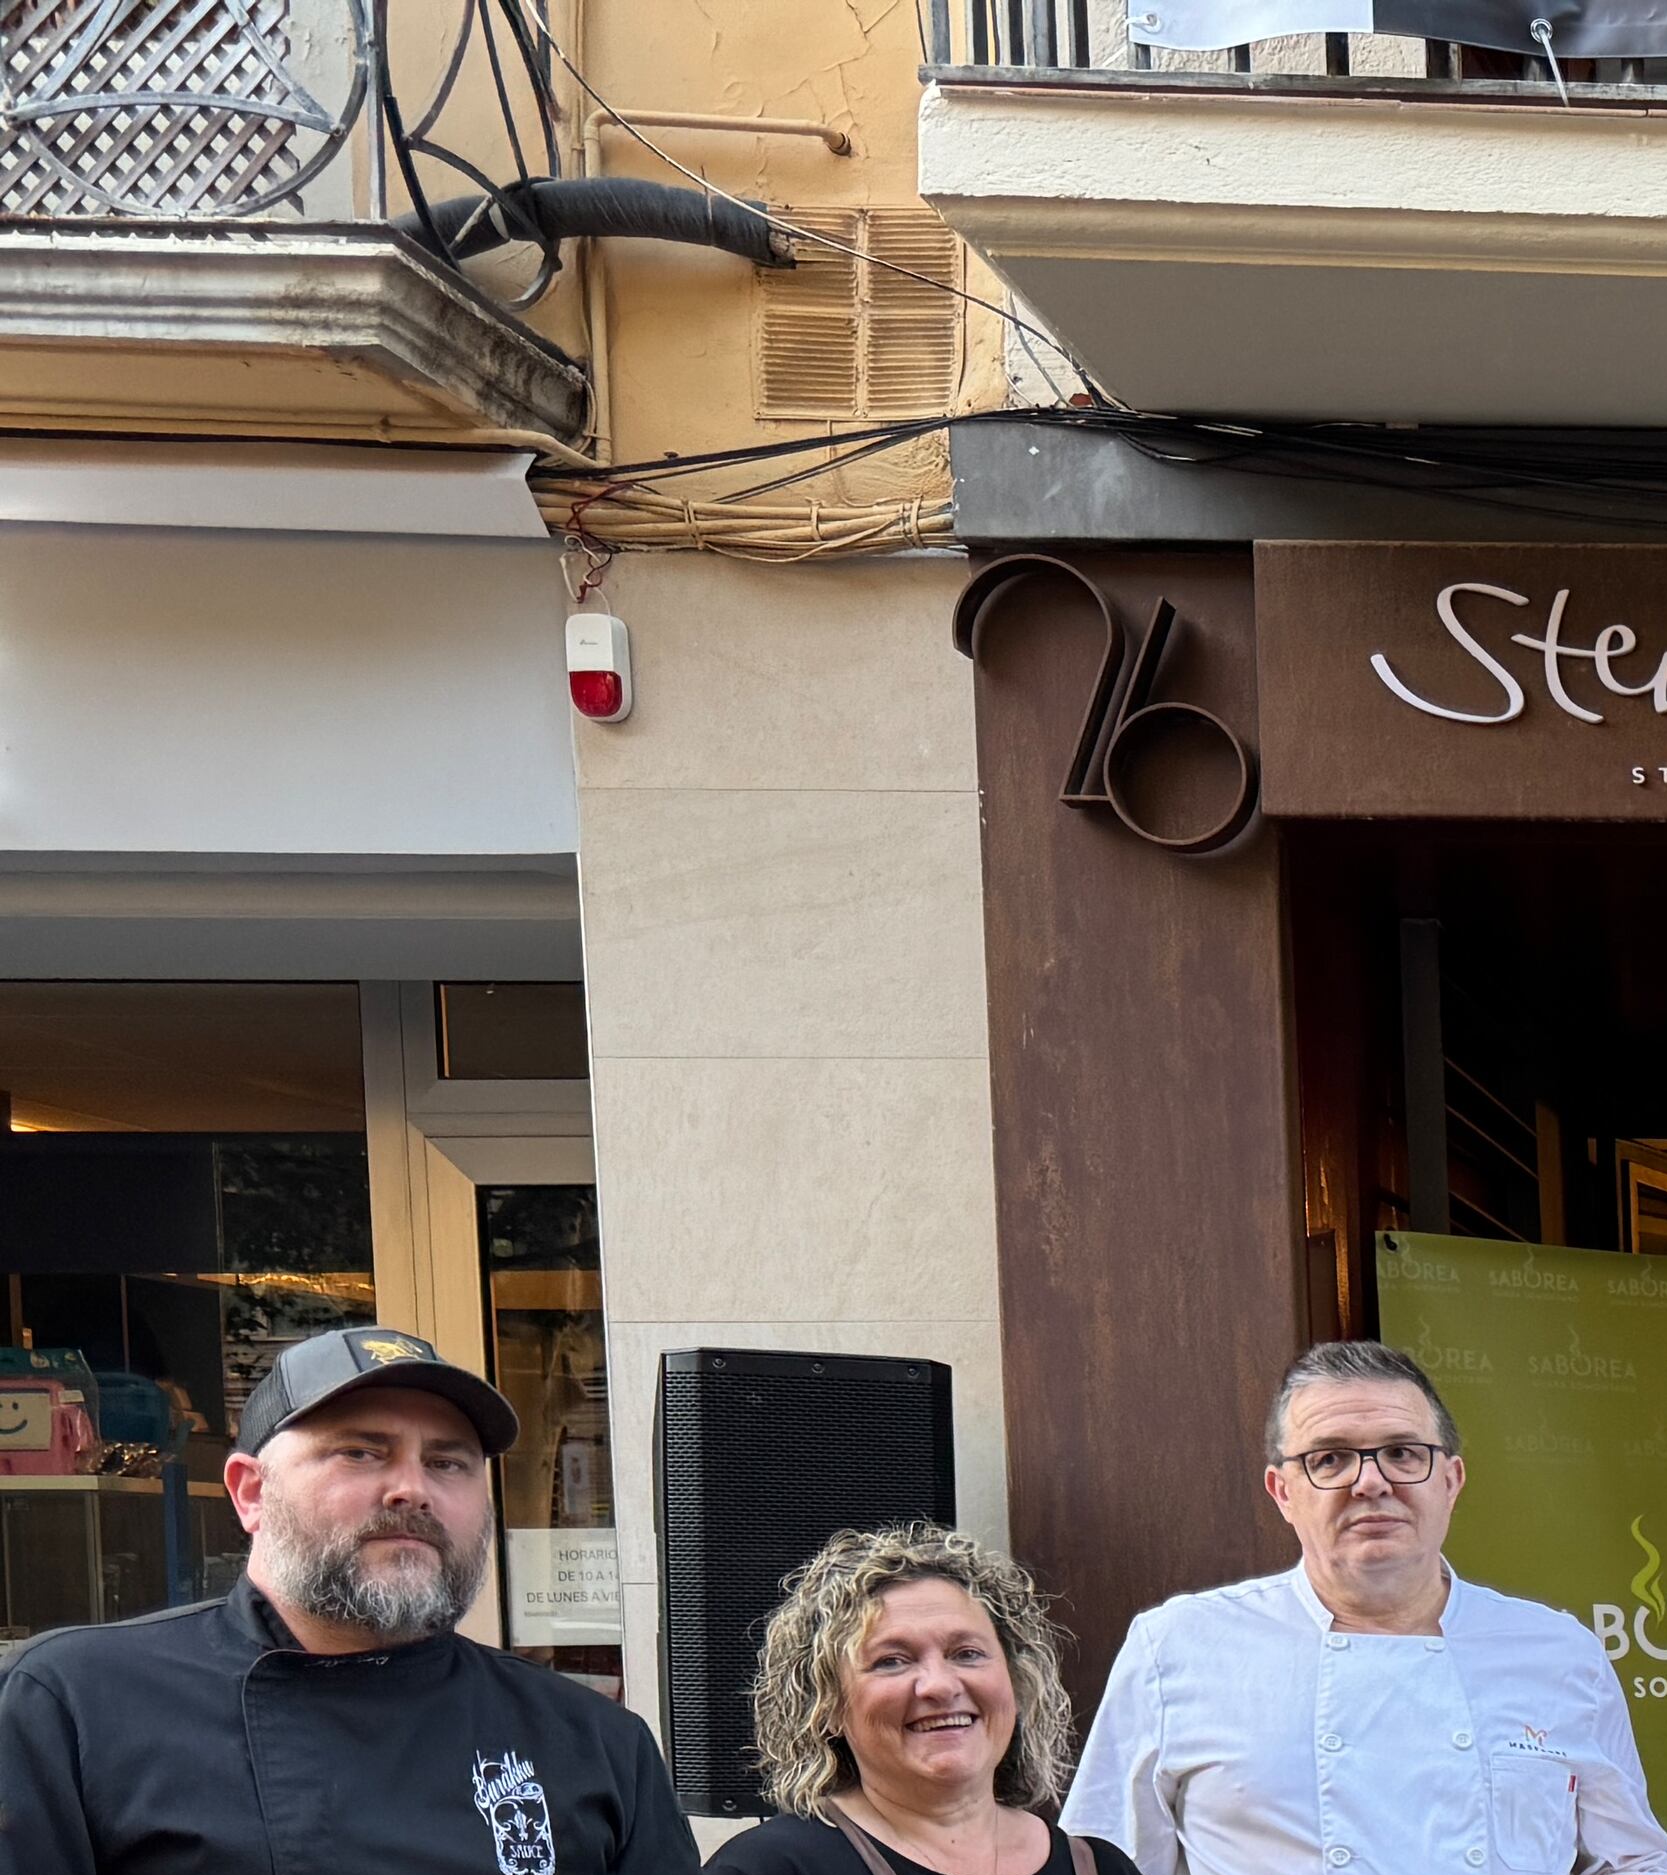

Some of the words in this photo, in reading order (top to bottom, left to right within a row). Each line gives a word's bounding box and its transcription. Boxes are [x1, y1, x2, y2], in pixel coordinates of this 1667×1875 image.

[1488, 1269, 1580, 1292] SABOREA
[1527, 1352, 1637, 1379] SABOREA
[559, 1550, 617, 1561] HORARIO
[558, 1571, 576, 1582] DE
[596, 1571, 605, 1581] A
[527, 1592, 545, 1603] DE
[547, 1592, 589, 1603] LUNES
[509, 1844, 544, 1858] SAUCE
